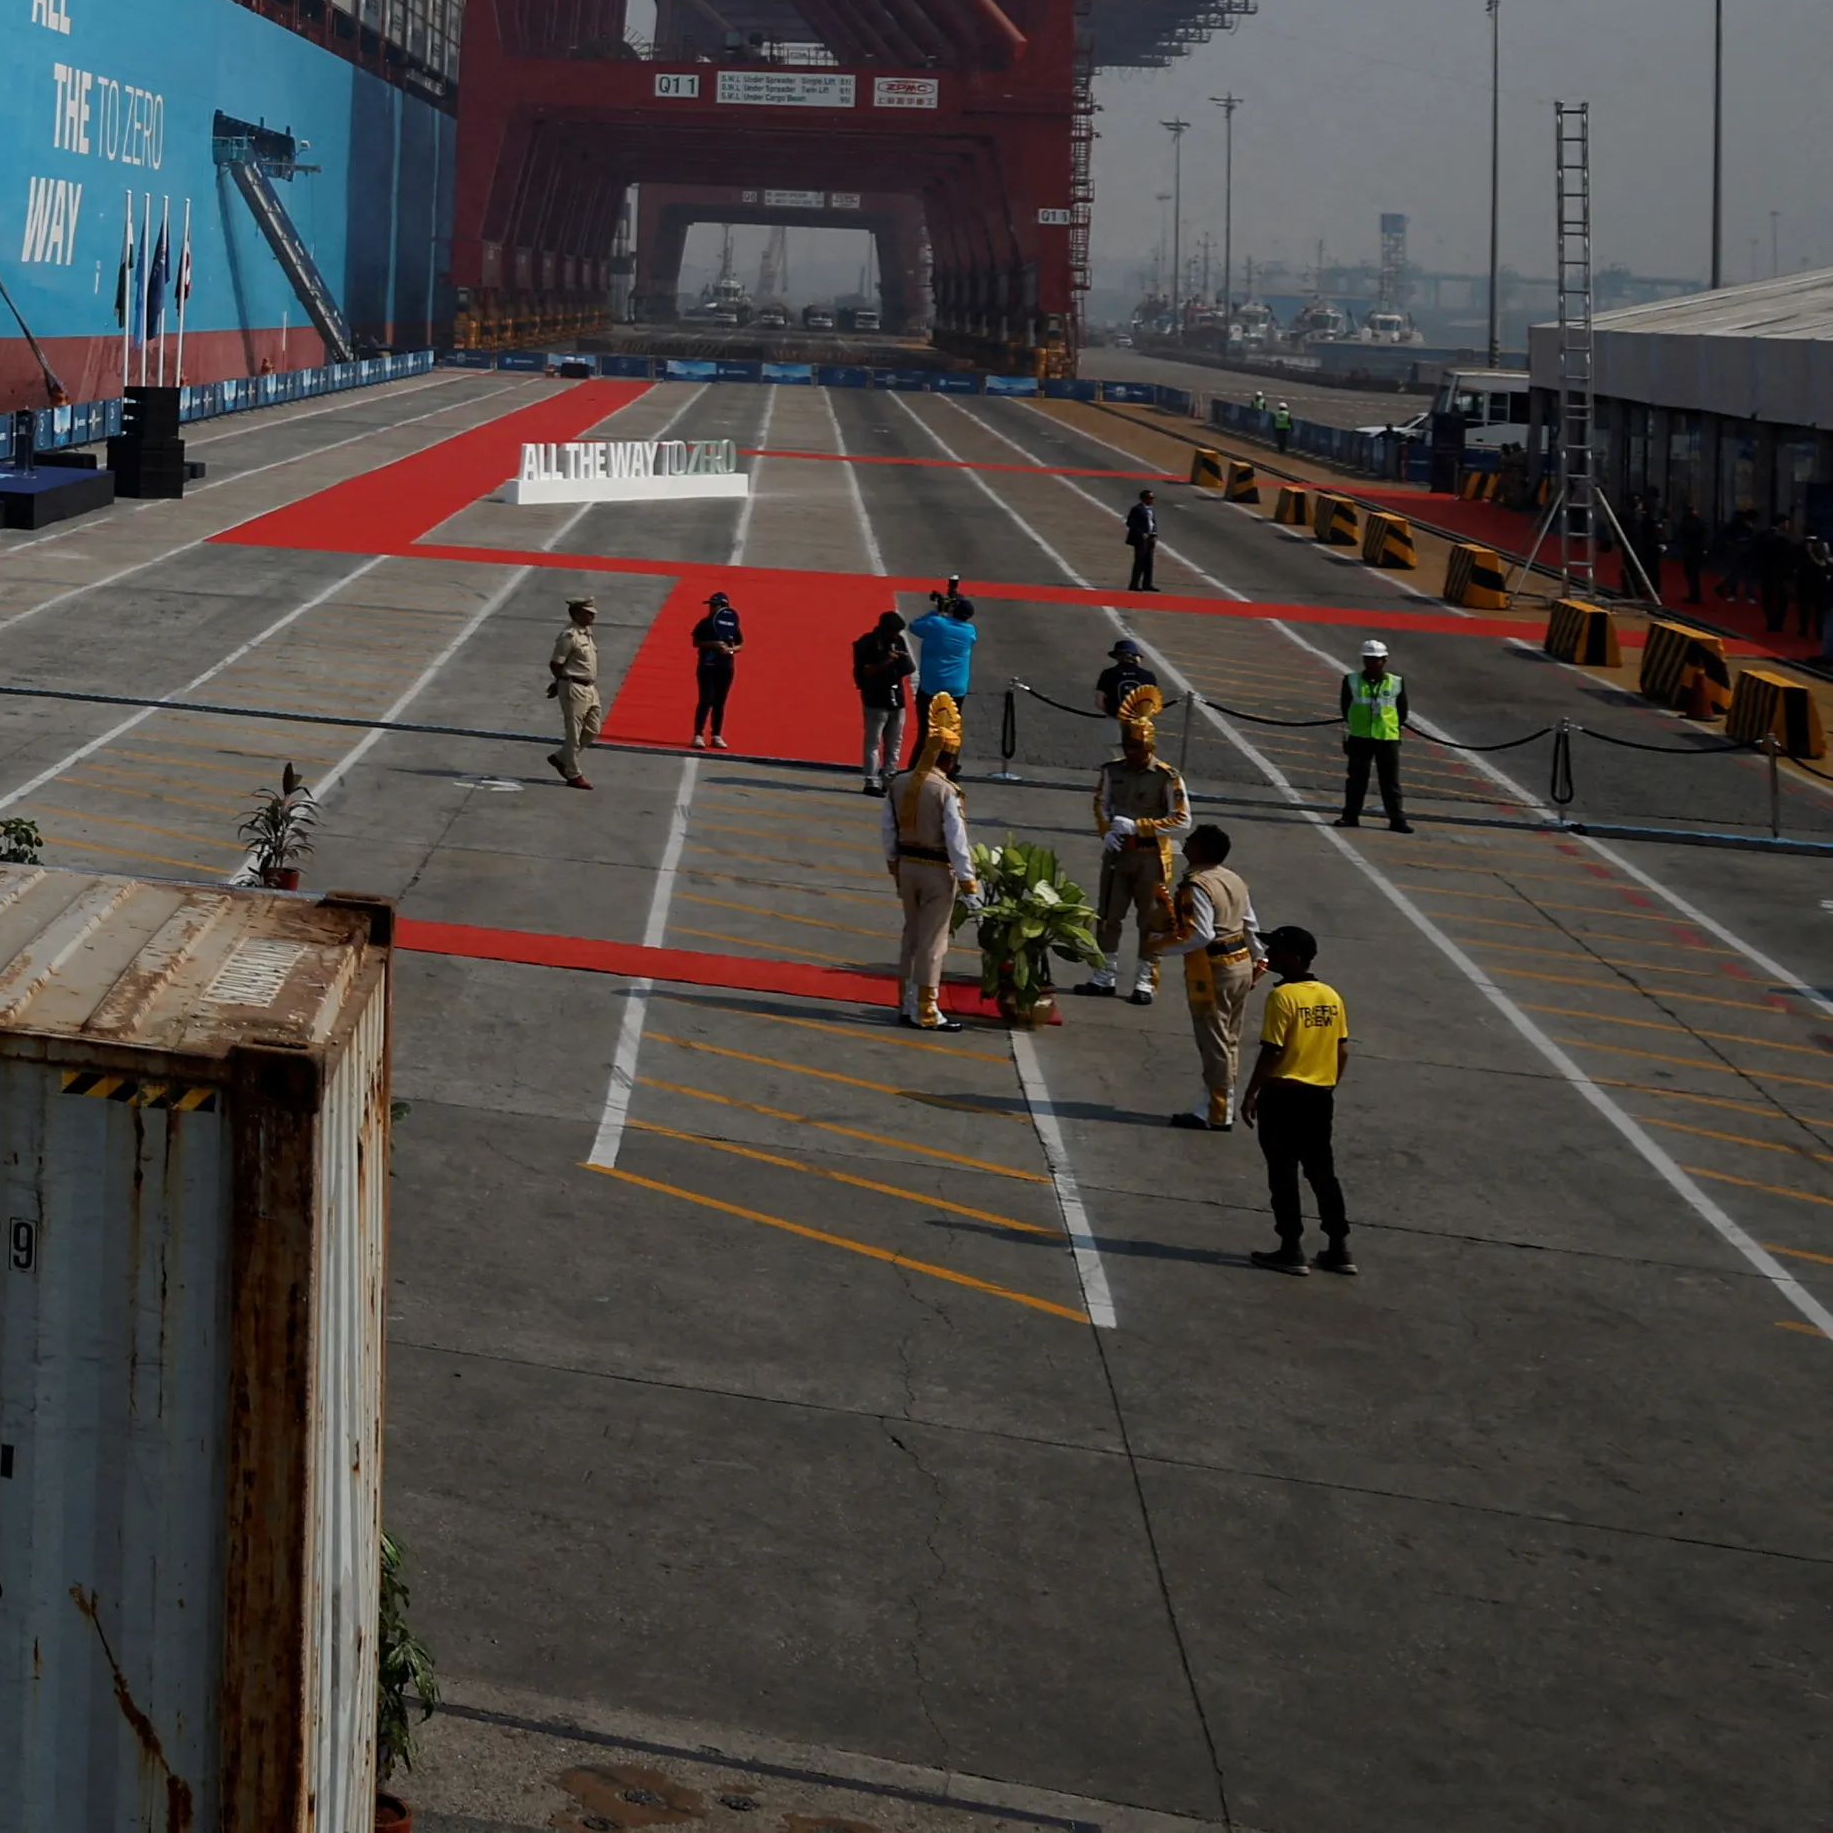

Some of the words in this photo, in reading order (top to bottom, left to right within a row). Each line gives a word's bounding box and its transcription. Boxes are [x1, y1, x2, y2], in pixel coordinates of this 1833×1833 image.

[658, 77, 696, 95] Q11
[886, 83, 927, 92] ZPMC
[53, 62, 92, 155] THE
[97, 77, 119, 161] TO
[122, 84, 164, 171] ZERO
[21, 176, 83, 266] WAY
[1040, 209, 1068, 223] Q11
[522, 443, 563, 480] ALL
[566, 442, 607, 479] THE
[610, 441, 658, 478] WAY
[661, 440, 687, 477] TO
[687, 439, 737, 475] ZERO
